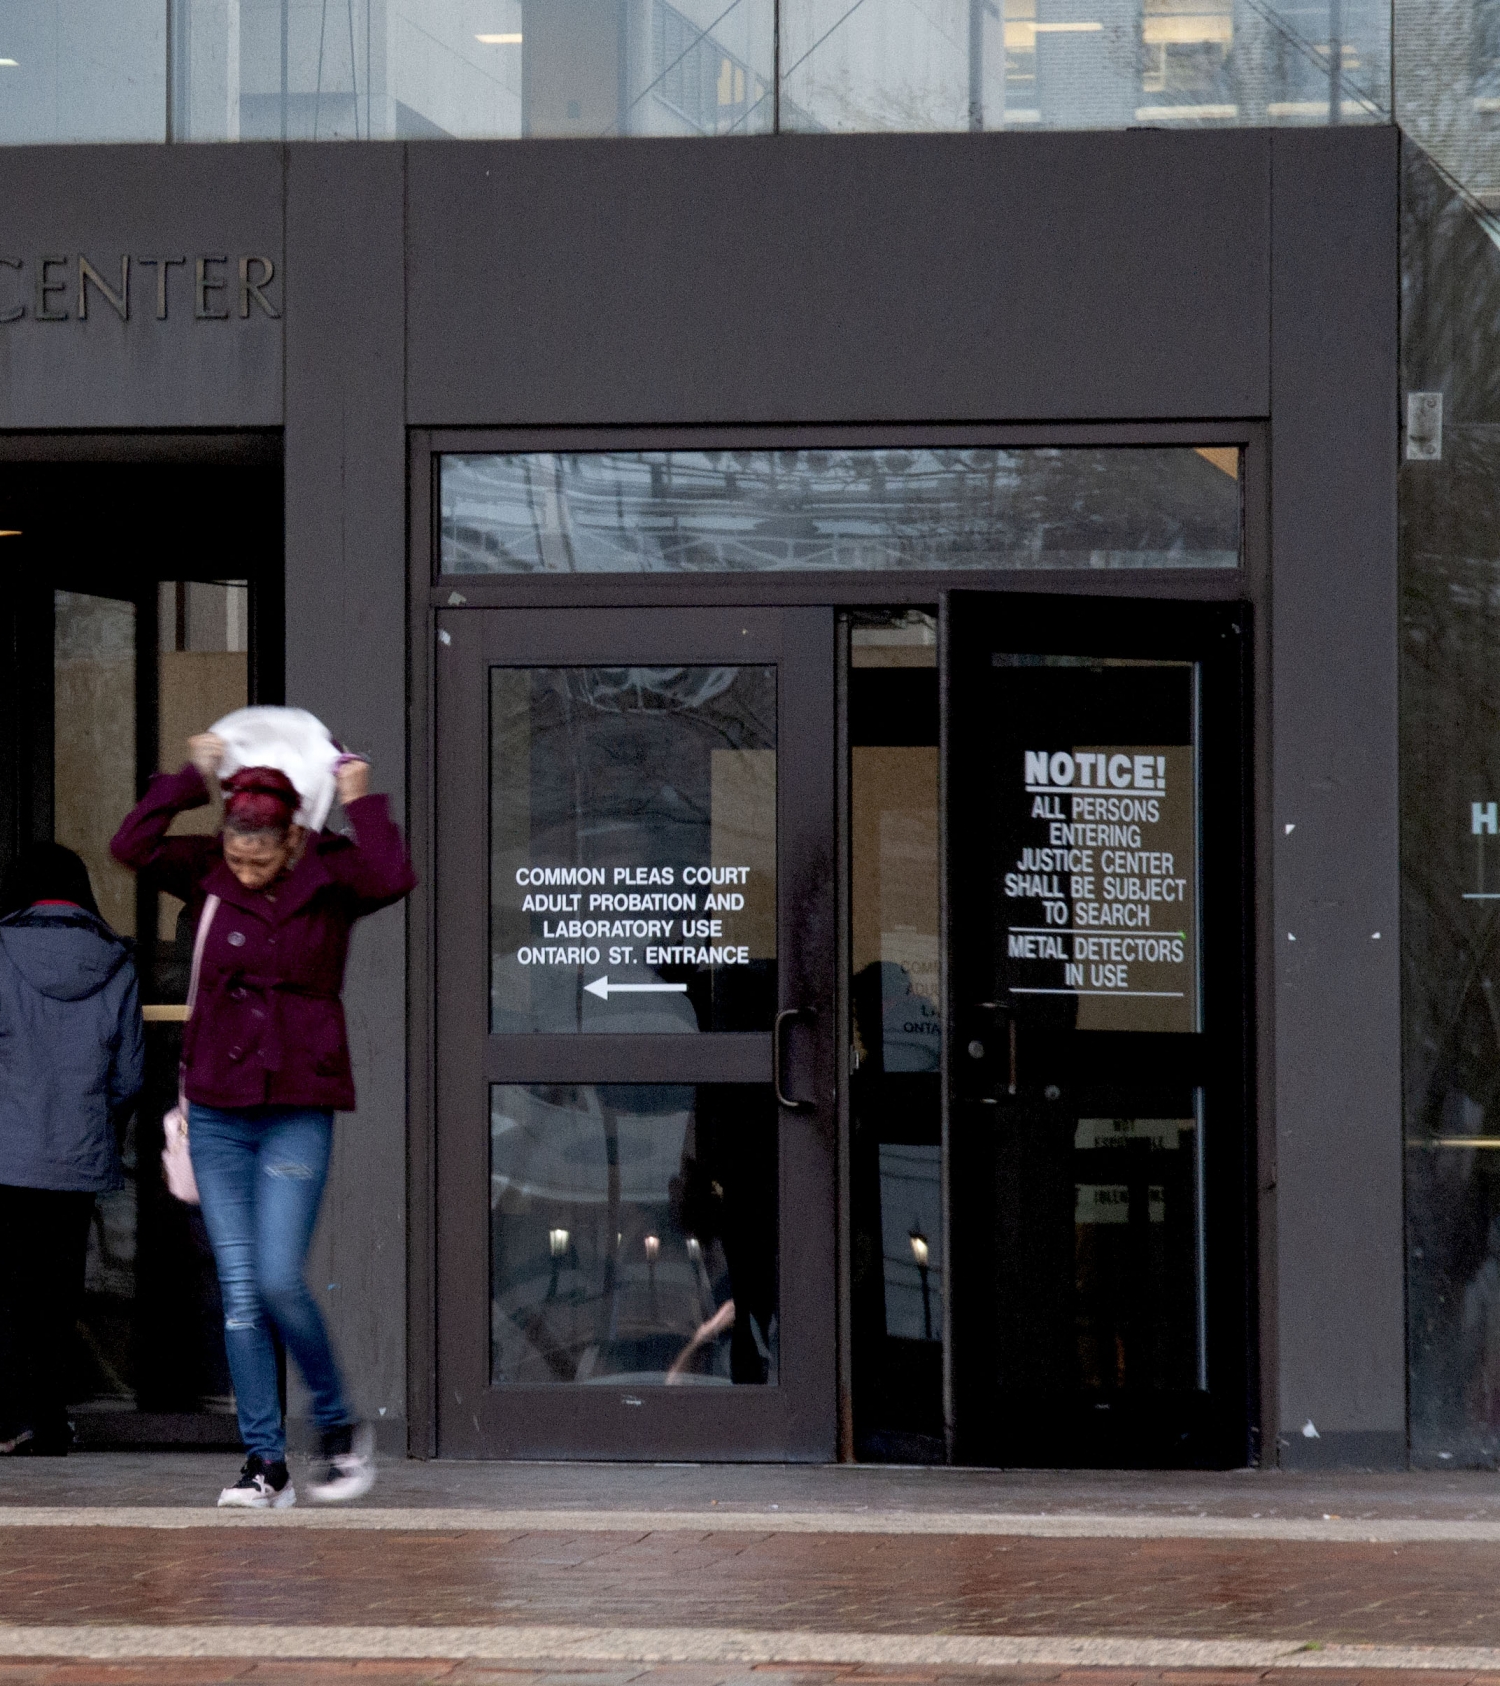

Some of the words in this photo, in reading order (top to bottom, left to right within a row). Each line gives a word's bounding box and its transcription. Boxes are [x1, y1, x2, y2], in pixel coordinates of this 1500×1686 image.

[1026, 752, 1165, 788] NOTICE!
[1033, 797, 1065, 818] ALL
[1073, 798, 1159, 822] PERSONS
[1051, 823, 1140, 848] ENTERING
[1018, 849, 1093, 872] JUSTICE
[1101, 850, 1173, 874] CENTER
[516, 868, 605, 885] COMMON
[614, 867, 674, 885] PLEAS
[683, 867, 750, 884] COURT
[1005, 874, 1063, 897] SHALL
[1071, 876, 1095, 899] BE
[1103, 876, 1186, 901] SUBJECT
[522, 894, 581, 911] ADULT
[590, 894, 695, 911] PROBATION
[704, 894, 744, 910] AND
[1043, 902, 1067, 924] TO
[1076, 902, 1149, 926] SEARCH
[544, 920, 673, 938] LABORATORY
[683, 920, 722, 937] USE
[517, 947, 600, 964] ONTARIO
[609, 946, 637, 964] ST.
[647, 946, 748, 964] ENTRANCE
[1009, 935, 1067, 959] METAL
[1075, 937, 1183, 962] DETECTORS
[1066, 964, 1083, 985] IN
[1091, 964, 1128, 987] USE
[903, 1021, 942, 1034] ONTA
